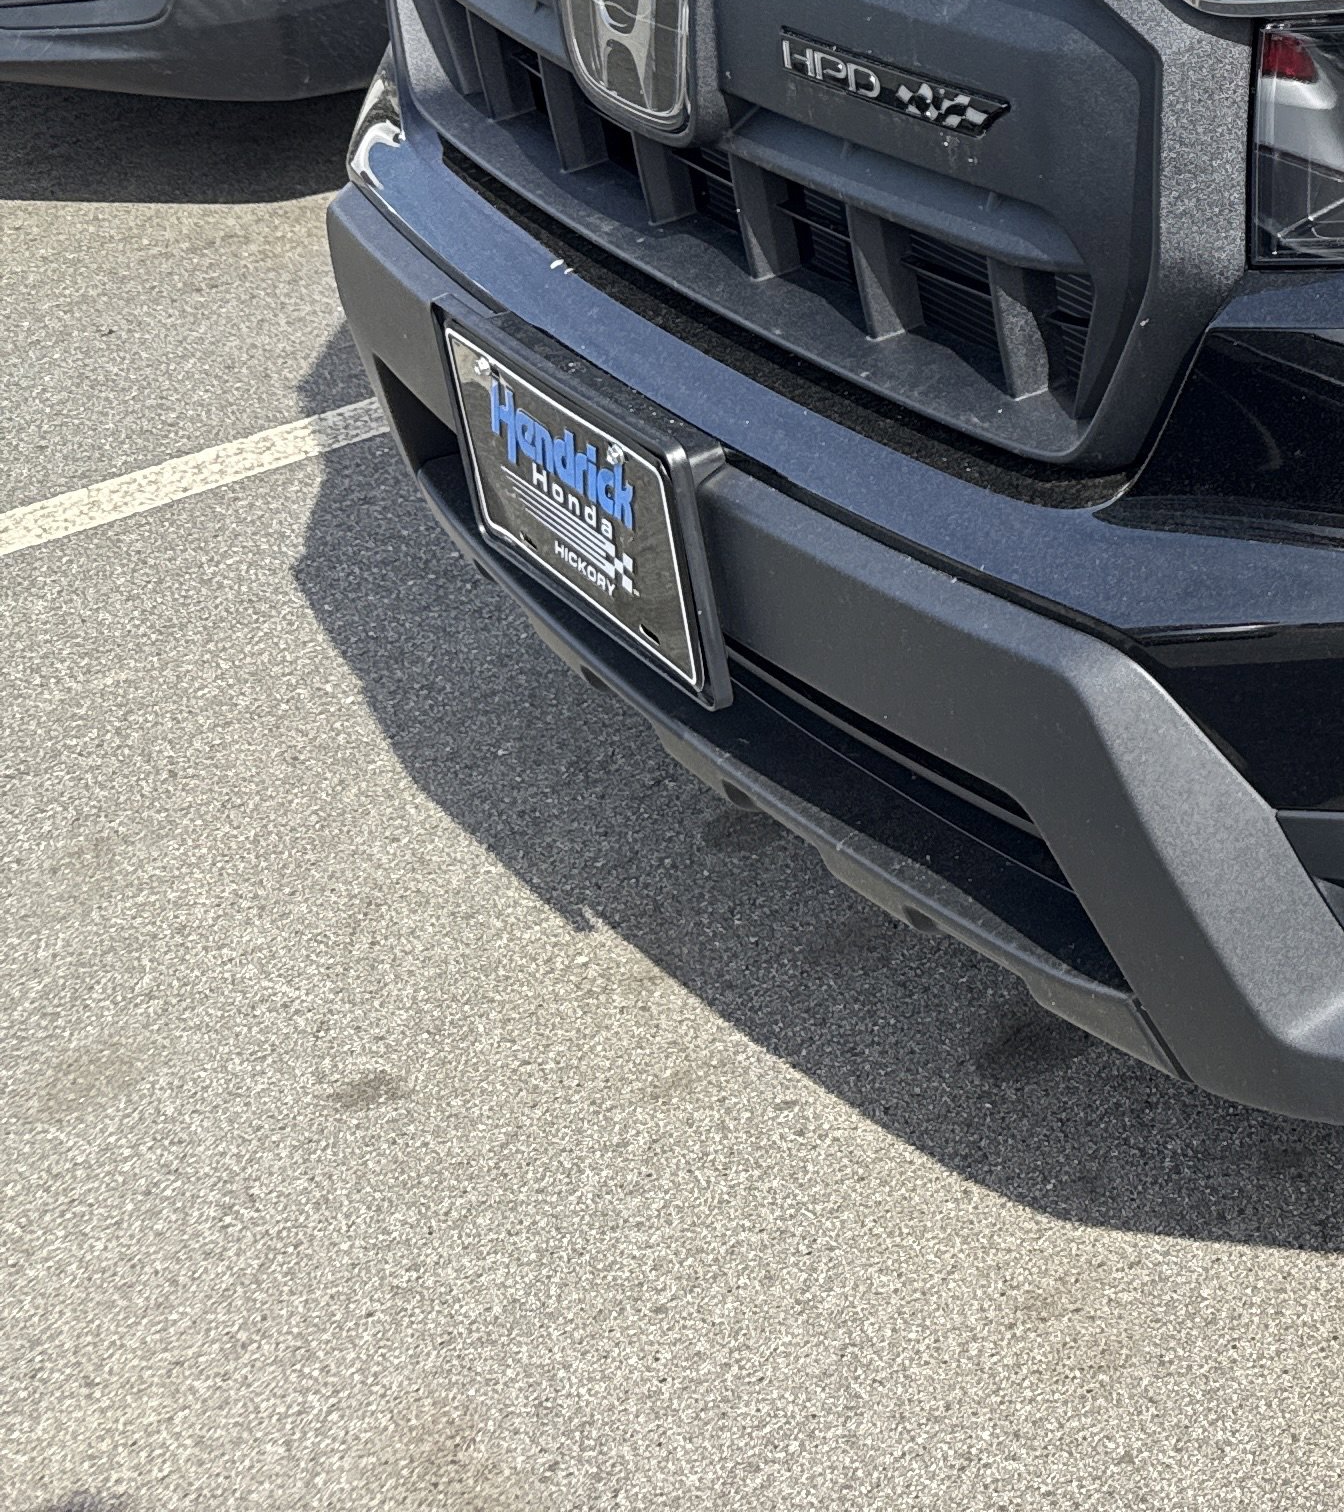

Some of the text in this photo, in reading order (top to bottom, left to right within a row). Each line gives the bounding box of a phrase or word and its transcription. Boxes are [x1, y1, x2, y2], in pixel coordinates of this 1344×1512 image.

[781, 39, 881, 99] HPD
[490, 380, 634, 531] Hendrick
[532, 461, 613, 539] Honda
[554, 540, 617, 598] HICKORY
